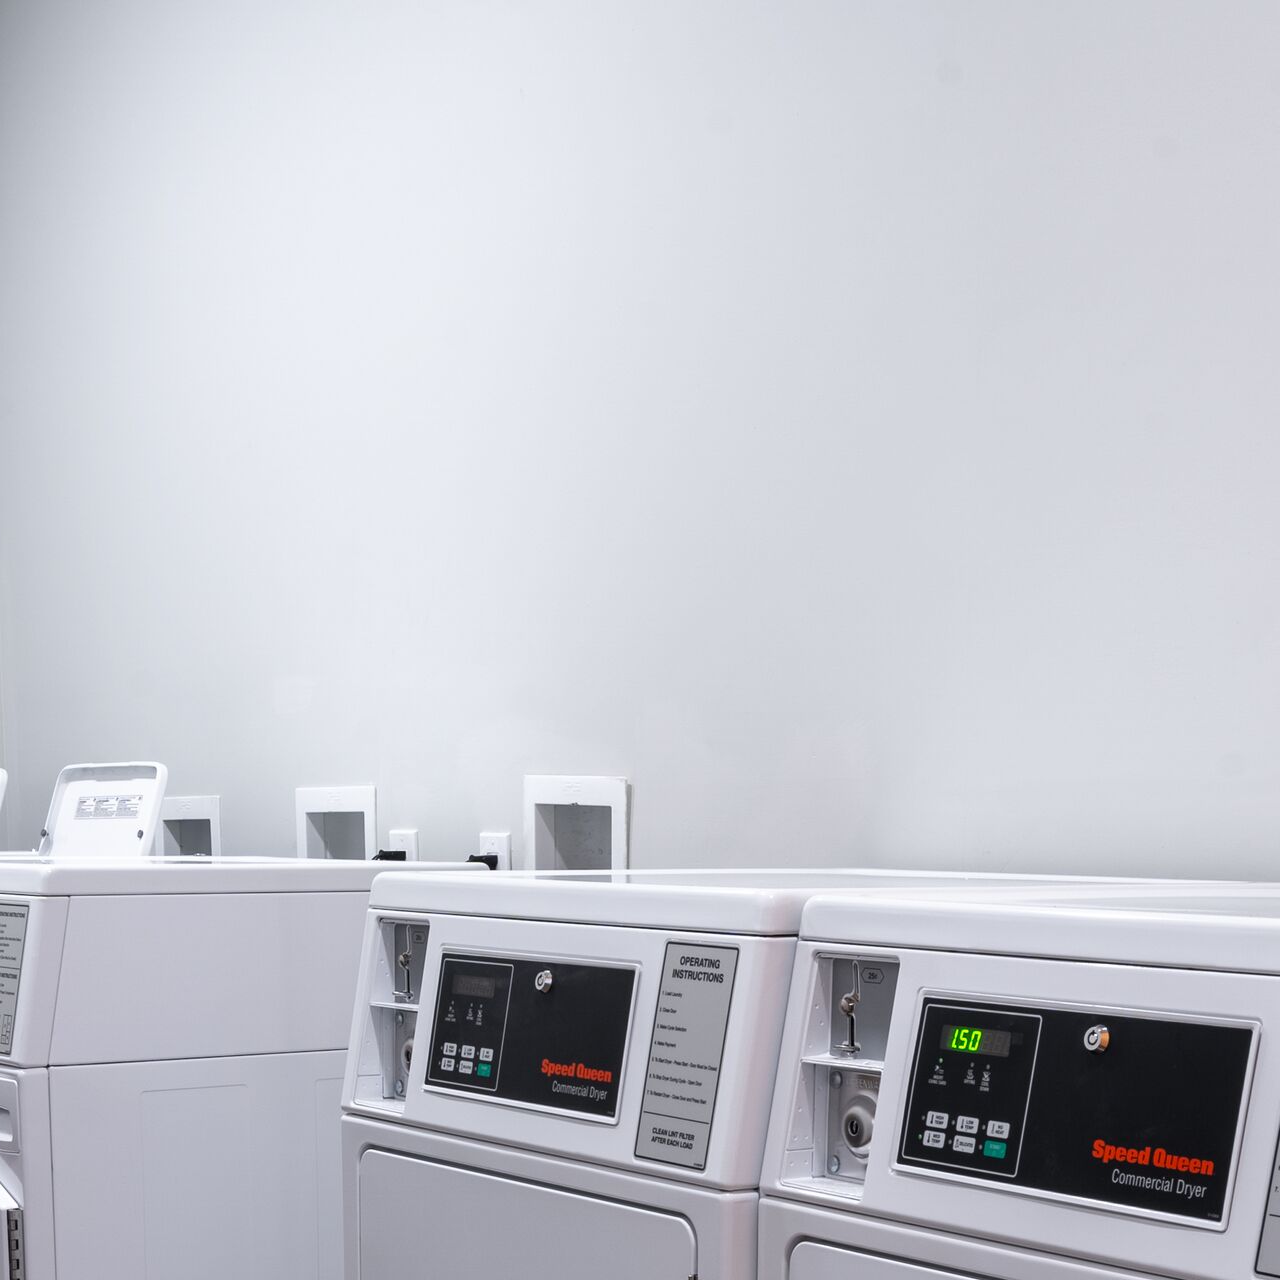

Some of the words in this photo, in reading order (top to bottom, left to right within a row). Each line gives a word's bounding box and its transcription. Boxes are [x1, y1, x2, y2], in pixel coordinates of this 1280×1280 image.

[680, 956, 720, 969] OPERATING
[672, 969, 724, 983] INSTRUCTIONS
[951, 1029, 982, 1051] 1.50
[541, 1059, 576, 1077] Speed
[576, 1063, 612, 1083] Queen
[552, 1080, 589, 1097] Commercial
[589, 1086, 608, 1101] Dryer
[651, 1136, 666, 1144] AFTER
[680, 1141, 693, 1150] LOAD
[652, 1127, 668, 1136] CLEAN
[679, 1132, 695, 1141] FILTER
[1092, 1139, 1151, 1163] Speed
[1153, 1148, 1214, 1175] Queen
[1112, 1168, 1174, 1192] Commercial
[1176, 1179, 1207, 1199] Dryer
